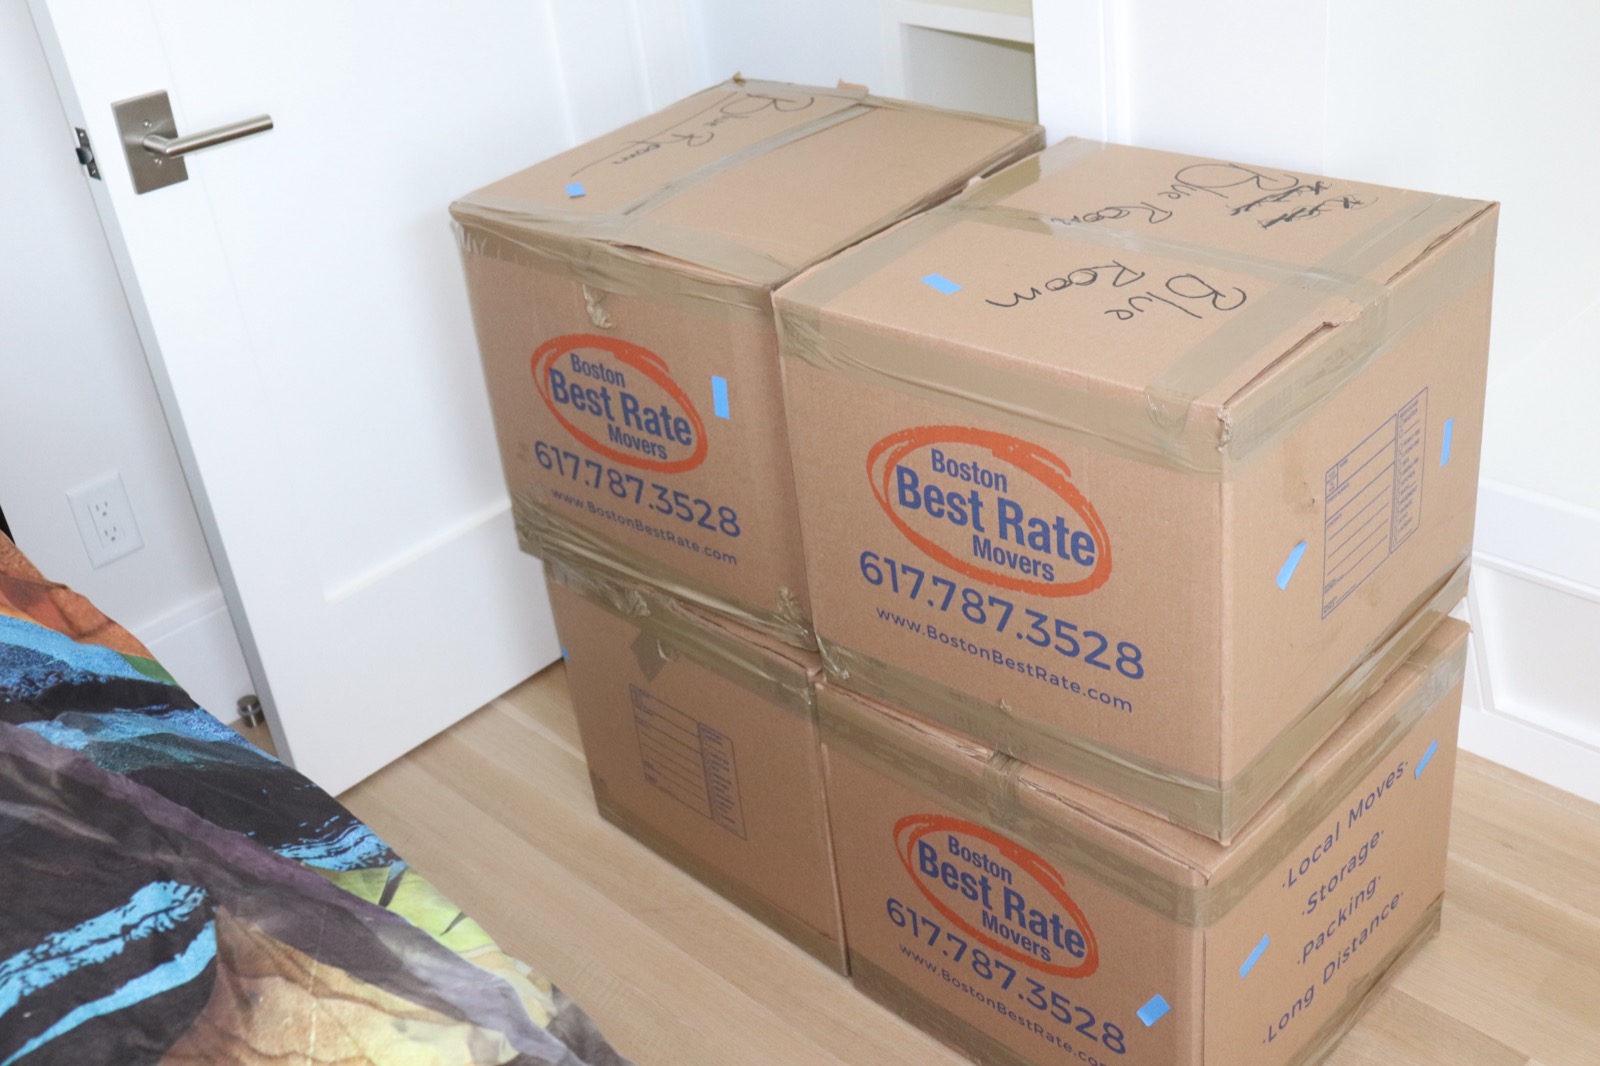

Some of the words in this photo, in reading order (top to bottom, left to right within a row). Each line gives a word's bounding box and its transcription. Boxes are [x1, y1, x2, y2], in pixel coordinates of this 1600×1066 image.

[1157, 163, 1299, 200] Blue
[1050, 201, 1173, 226] Room
[985, 259, 1146, 308] Room
[1103, 272, 1247, 321] Blue
[570, 352, 626, 389] Boston
[549, 367, 615, 422] Best
[619, 391, 693, 447] Rate
[607, 423, 668, 460] Movers
[534, 440, 741, 538] 617.787.3528
[931, 448, 1008, 494] Boston
[551, 488, 738, 566] www.BostonBestRate.com
[896, 464, 985, 533] Best
[997, 496, 1096, 567] Rate
[972, 534, 1055, 582] Movers
[859, 550, 1145, 681] 617.787.3528
[876, 606, 1133, 714] www.BostonBestRate.com
[948, 834, 1013, 885] Boston
[917, 838, 993, 911] Best
[1003, 886, 1086, 960] Rate
[982, 909, 1052, 962] Movers
[886, 897, 1126, 1056] 617.787.3528
